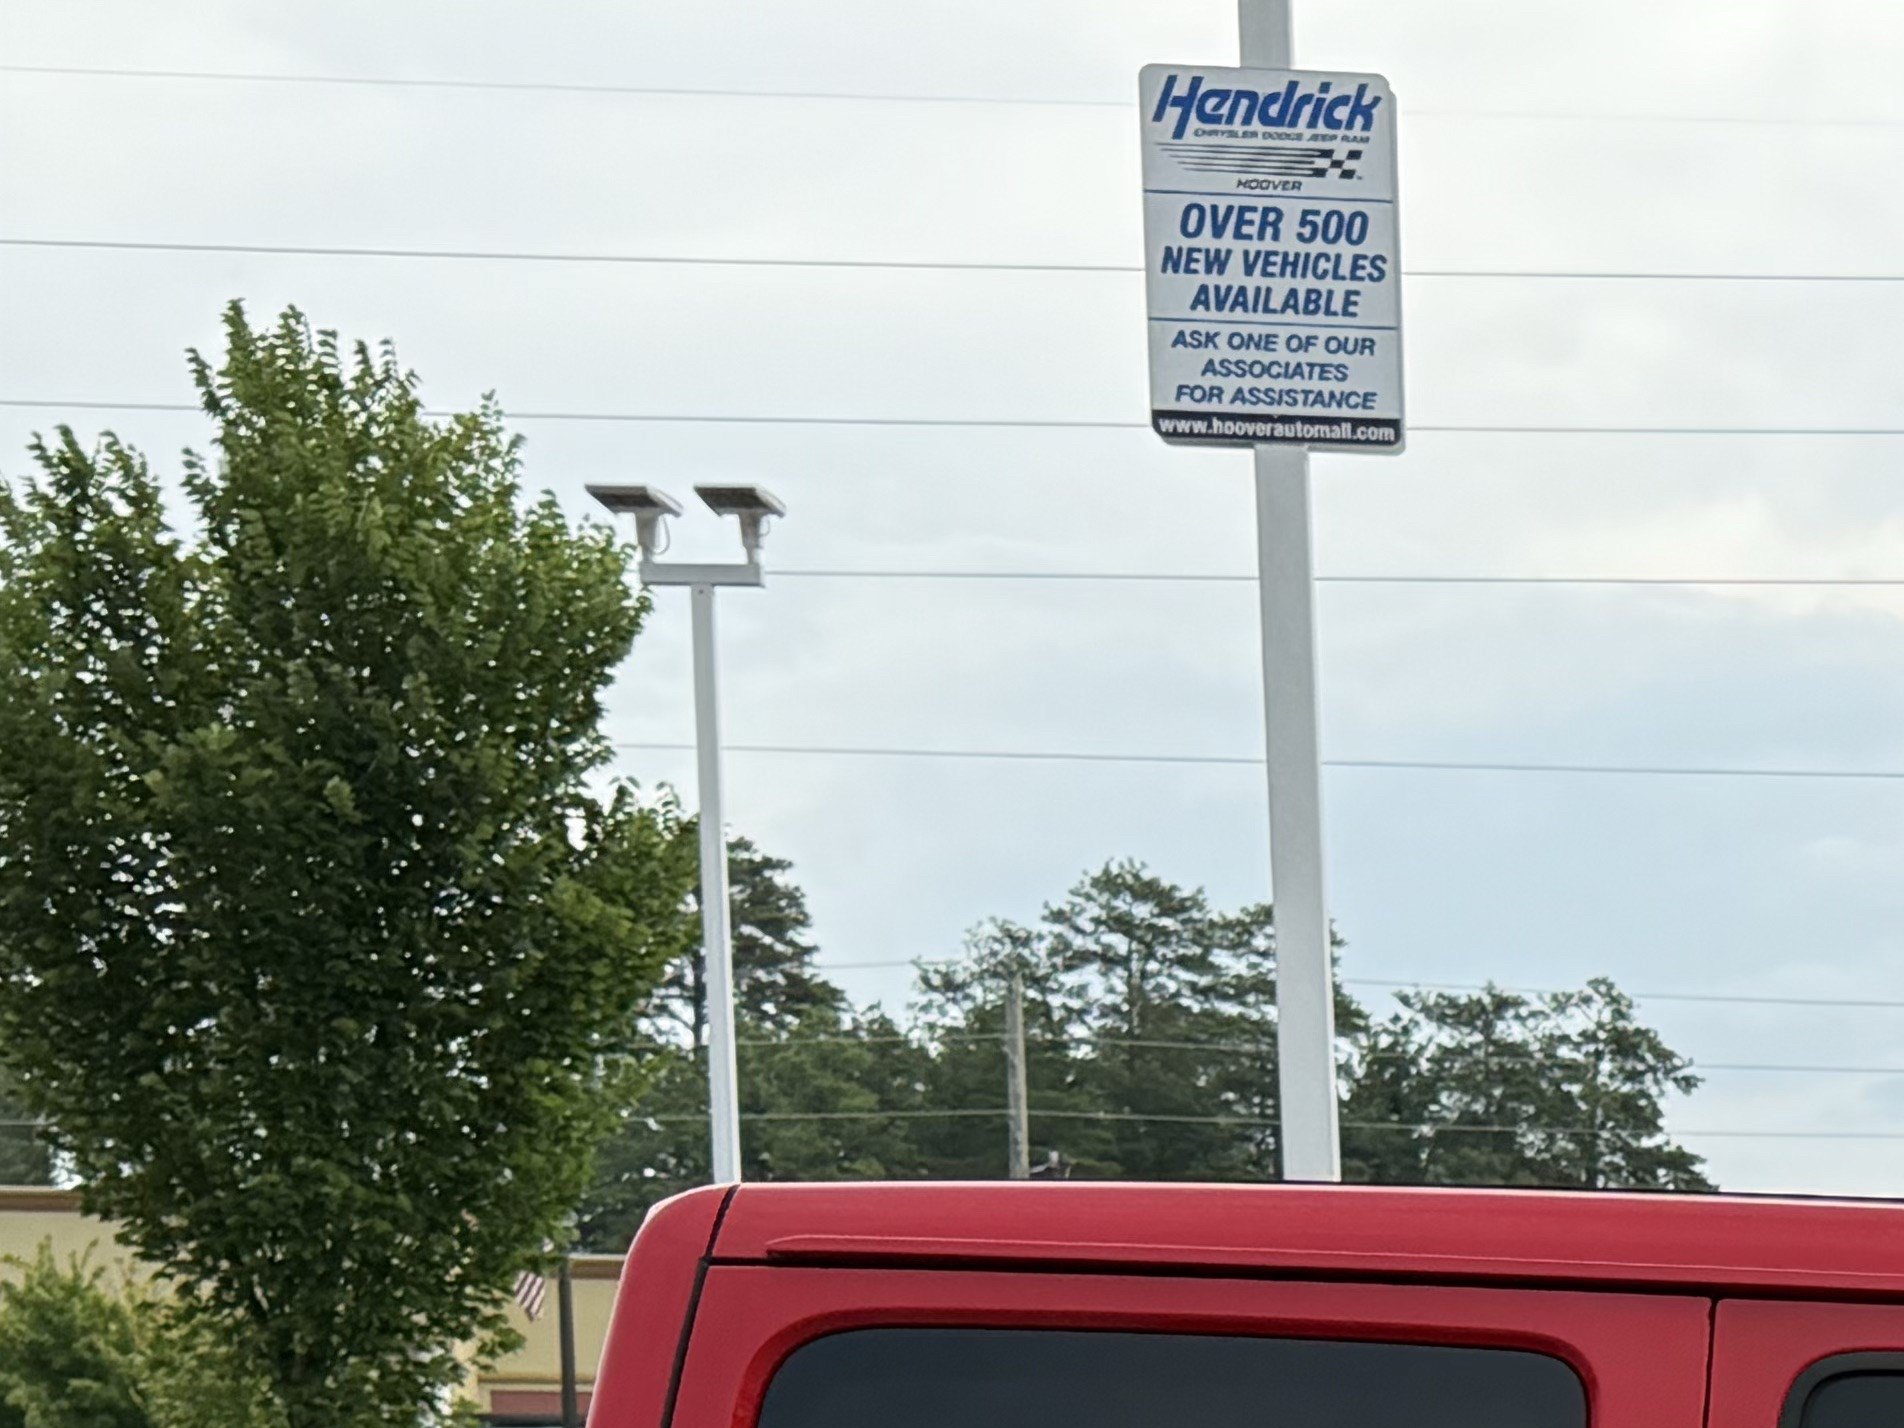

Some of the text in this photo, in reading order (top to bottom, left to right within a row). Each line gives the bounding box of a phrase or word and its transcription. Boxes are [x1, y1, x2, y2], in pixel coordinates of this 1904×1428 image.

[1152, 74, 1382, 140] Hendrick
[1193, 128, 1370, 143] CHRYSLER DODGE JEEP RAM
[1236, 178, 1302, 191] HOOVER
[1179, 203, 1369, 246] OVER 500
[1161, 246, 1388, 283] NEW VEHICLES
[1190, 284, 1361, 317] AVAILABLE
[1171, 330, 1376, 356] ASK ONE OF OUR
[1201, 358, 1349, 381] ASSOCIATES
[1175, 385, 1377, 410] FOR ASSISTANCE
[1159, 417, 1395, 442] www.hooverautomall.com
